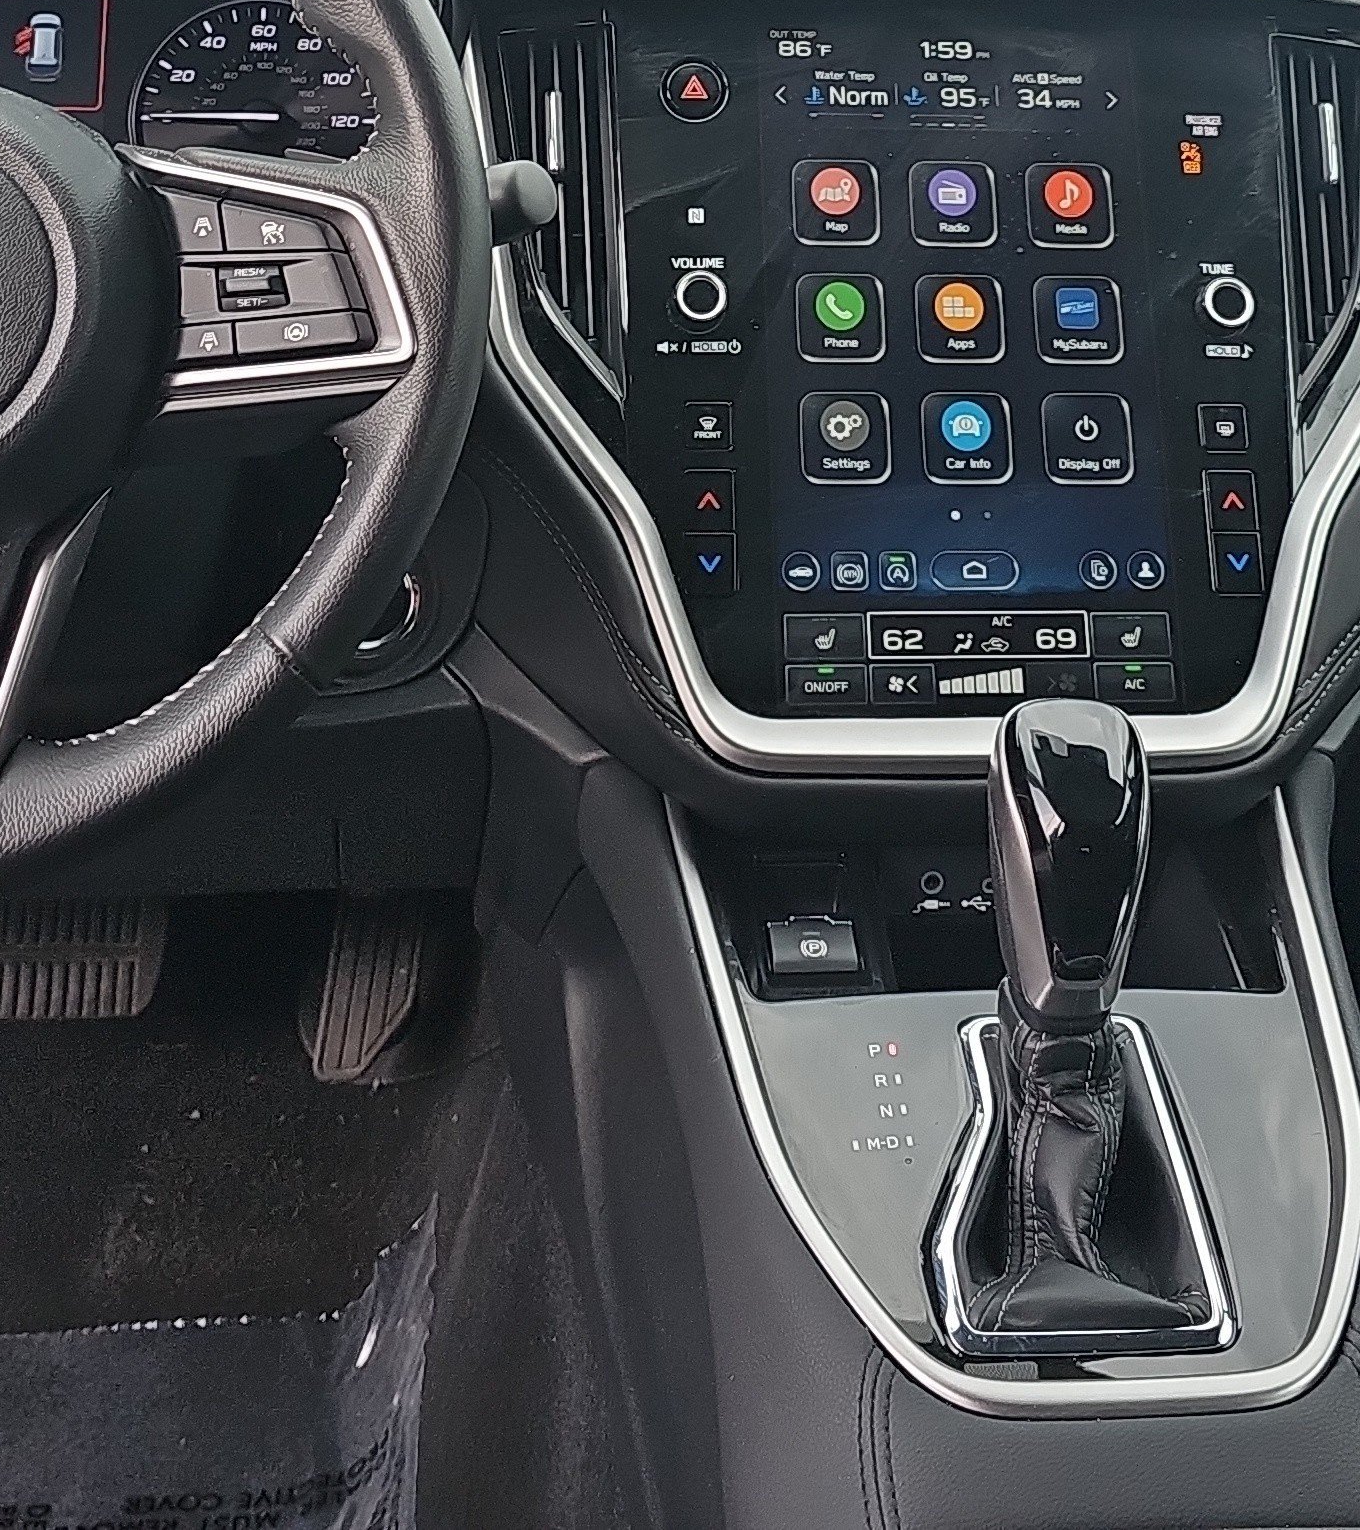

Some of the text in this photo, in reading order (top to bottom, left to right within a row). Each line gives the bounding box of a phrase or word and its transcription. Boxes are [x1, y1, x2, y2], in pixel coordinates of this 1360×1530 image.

[250, 24, 277, 38] 60
[769, 30, 789, 39] OUT
[199, 36, 323, 52] 40 80
[249, 42, 278, 52] MPH
[778, 40, 812, 57] 86
[919, 41, 973, 60] 1:59
[169, 70, 196, 83] 20
[322, 72, 352, 86] 100
[814, 70, 876, 82] Water Temp
[923, 72, 969, 84] Oil Temp
[1049, 73, 1083, 86] Speed
[829, 85, 889, 106] Norm
[940, 87, 977, 108] 95
[1016, 88, 1081, 109] 34 MPH
[330, 115, 360, 128] 120
[825, 221, 849, 233] Map
[939, 222, 971, 233] Radio
[1055, 223, 1088, 235] Media
[671, 257, 725, 269] VOLUME
[1199, 262, 1235, 275] TUNE
[693, 342, 726, 352] HOLD
[824, 336, 859, 348] Phone
[946, 337, 976, 350] Apps
[1053, 338, 1108, 352] MySubaru
[1207, 346, 1239, 356] HOLD
[693, 431, 722, 439] FRONT
[822, 457, 871, 471] Settings
[945, 457, 992, 470] Car Info
[1058, 457, 1122, 472] Display Off
[991, 615, 1013, 628] A/C
[882, 628, 1078, 651] 62 69
[804, 681, 849, 693] ON/OFF
[1124, 678, 1145, 690] A/C
[868, 1044, 881, 1058] P
[874, 1074, 889, 1088] R
[879, 1103, 894, 1118] N
